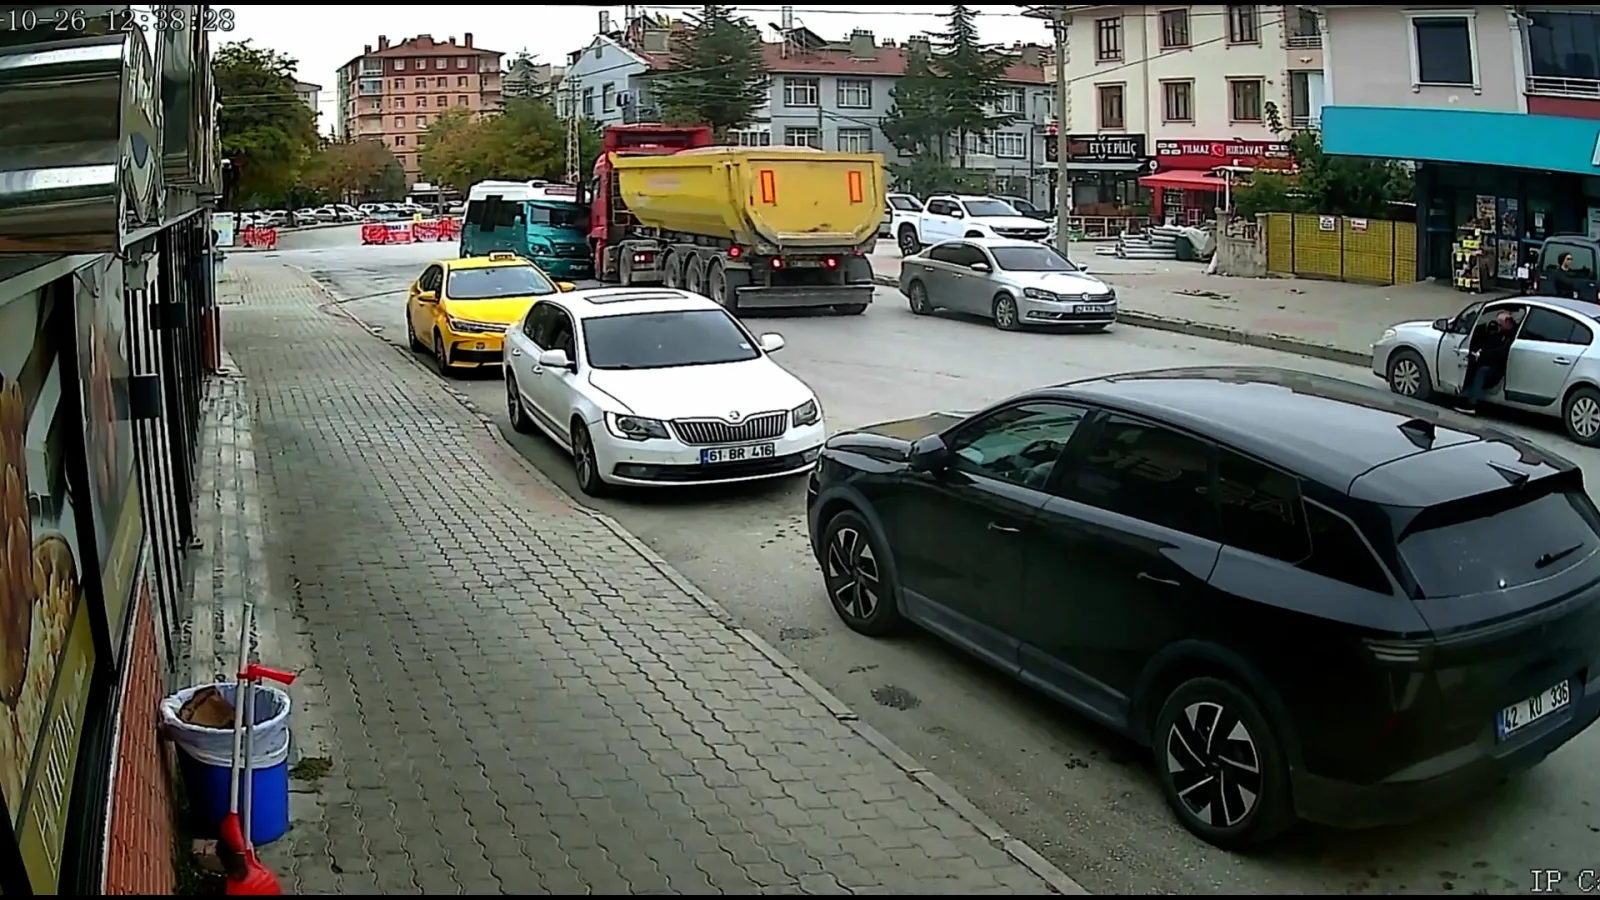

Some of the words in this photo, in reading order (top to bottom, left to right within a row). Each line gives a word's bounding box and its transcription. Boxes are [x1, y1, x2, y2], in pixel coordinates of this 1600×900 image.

[709, 450, 722, 461] 61
[729, 448, 745, 460] BR
[752, 444, 772, 457] 416
[1504, 706, 1518, 730] 42
[1529, 695, 1542, 719] KU
[1550, 682, 1568, 708] 336
